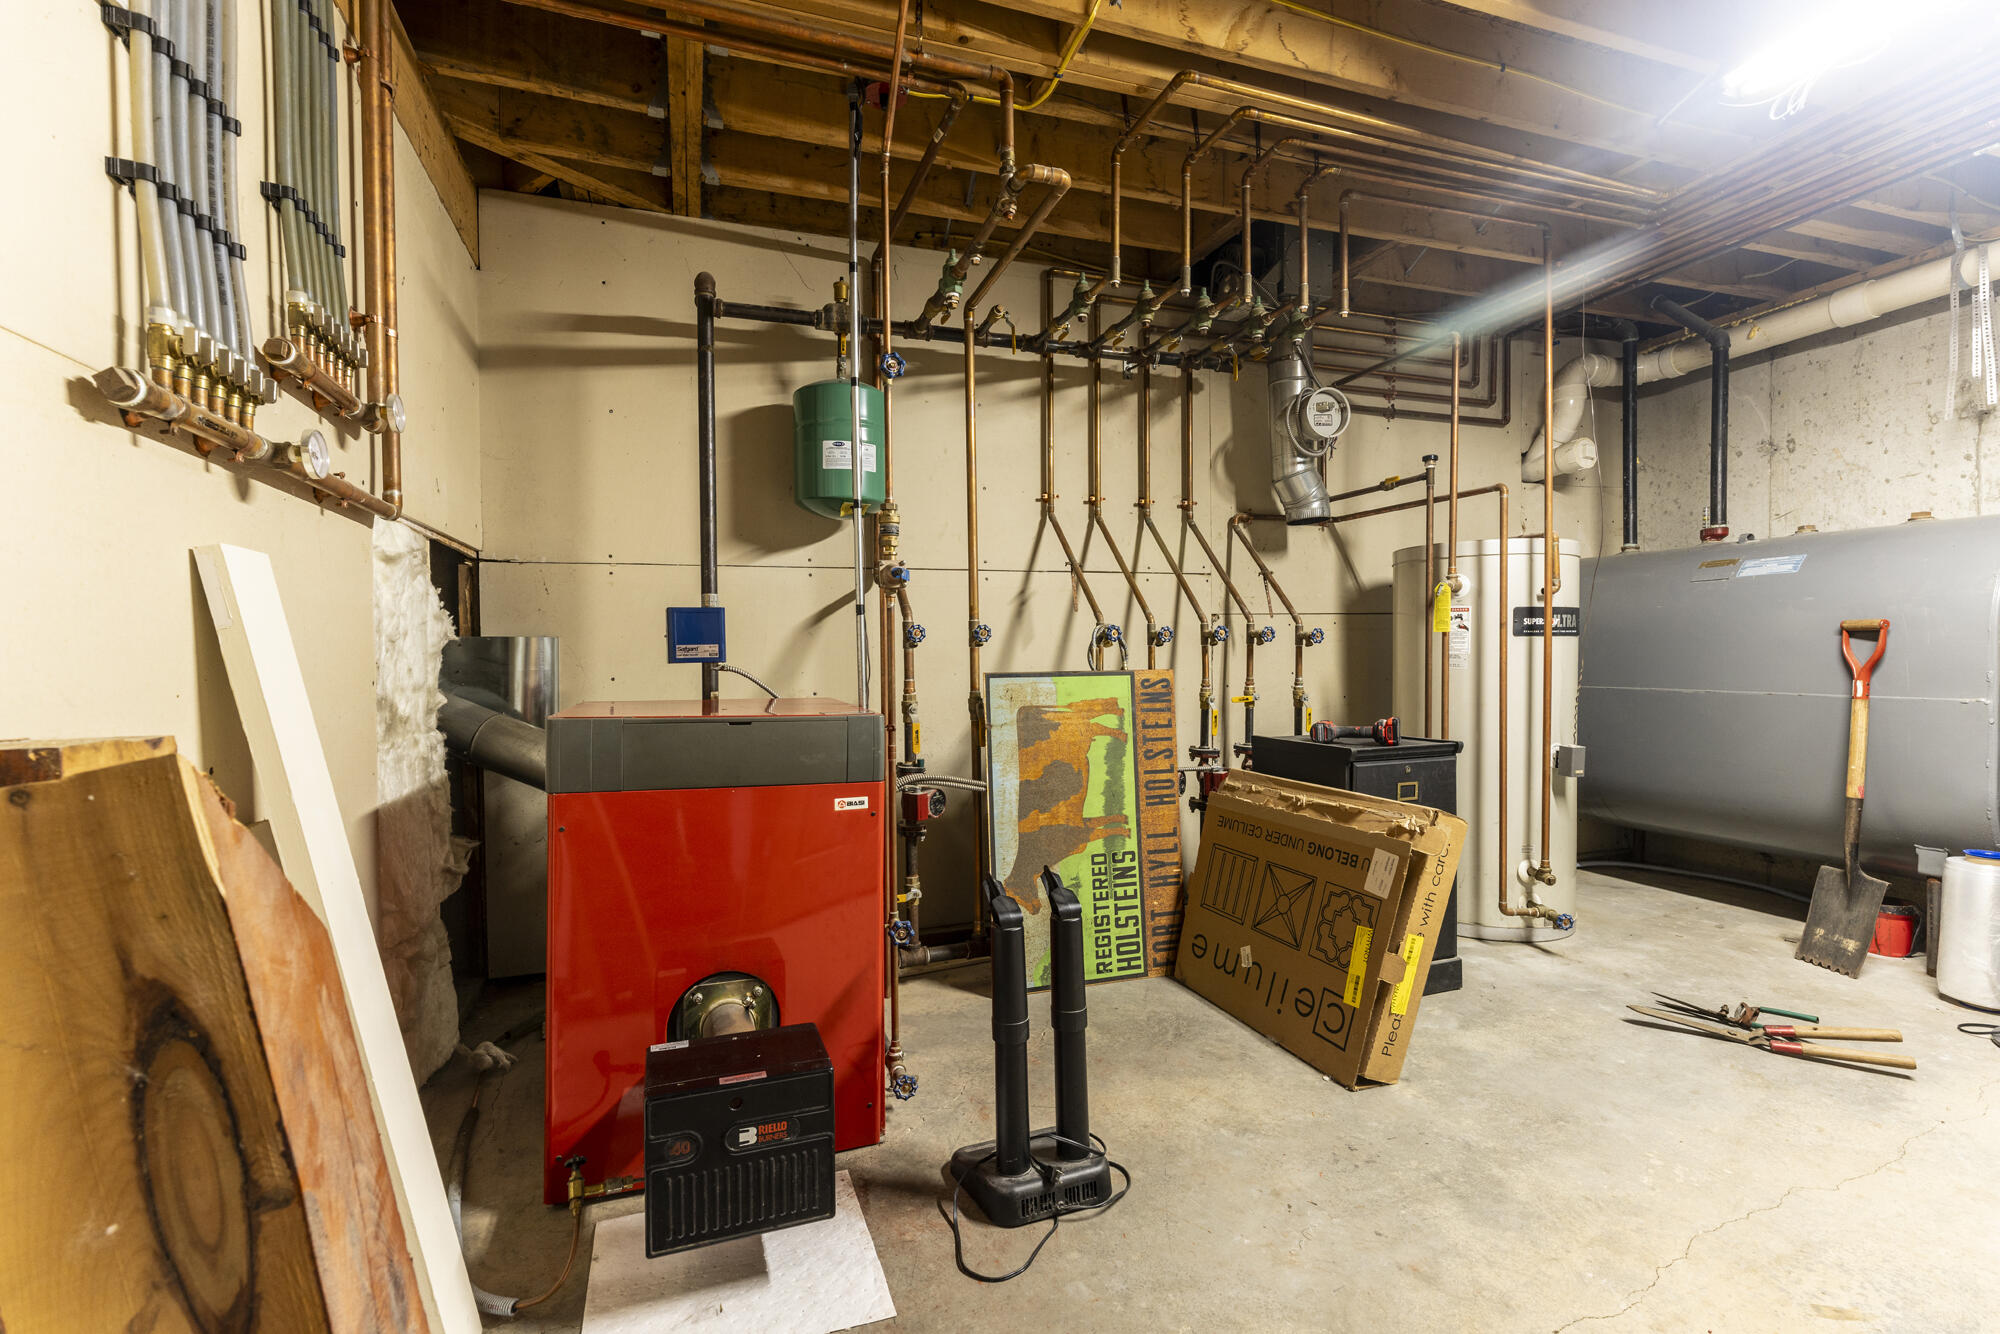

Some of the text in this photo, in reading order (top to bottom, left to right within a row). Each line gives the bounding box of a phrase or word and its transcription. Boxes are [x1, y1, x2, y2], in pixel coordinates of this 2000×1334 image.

[1140, 677, 1183, 969] FORT HYLL HOLSTEINS
[1217, 815, 1262, 838] CEILUME
[1265, 829, 1304, 850] UNDER
[1308, 841, 1359, 868] BELONG
[1091, 852, 1113, 975] REGISTERED
[1112, 850, 1142, 972] HOLSTEINS
[1419, 891, 1437, 927] with
[758, 1121, 788, 1135] RIELLO
